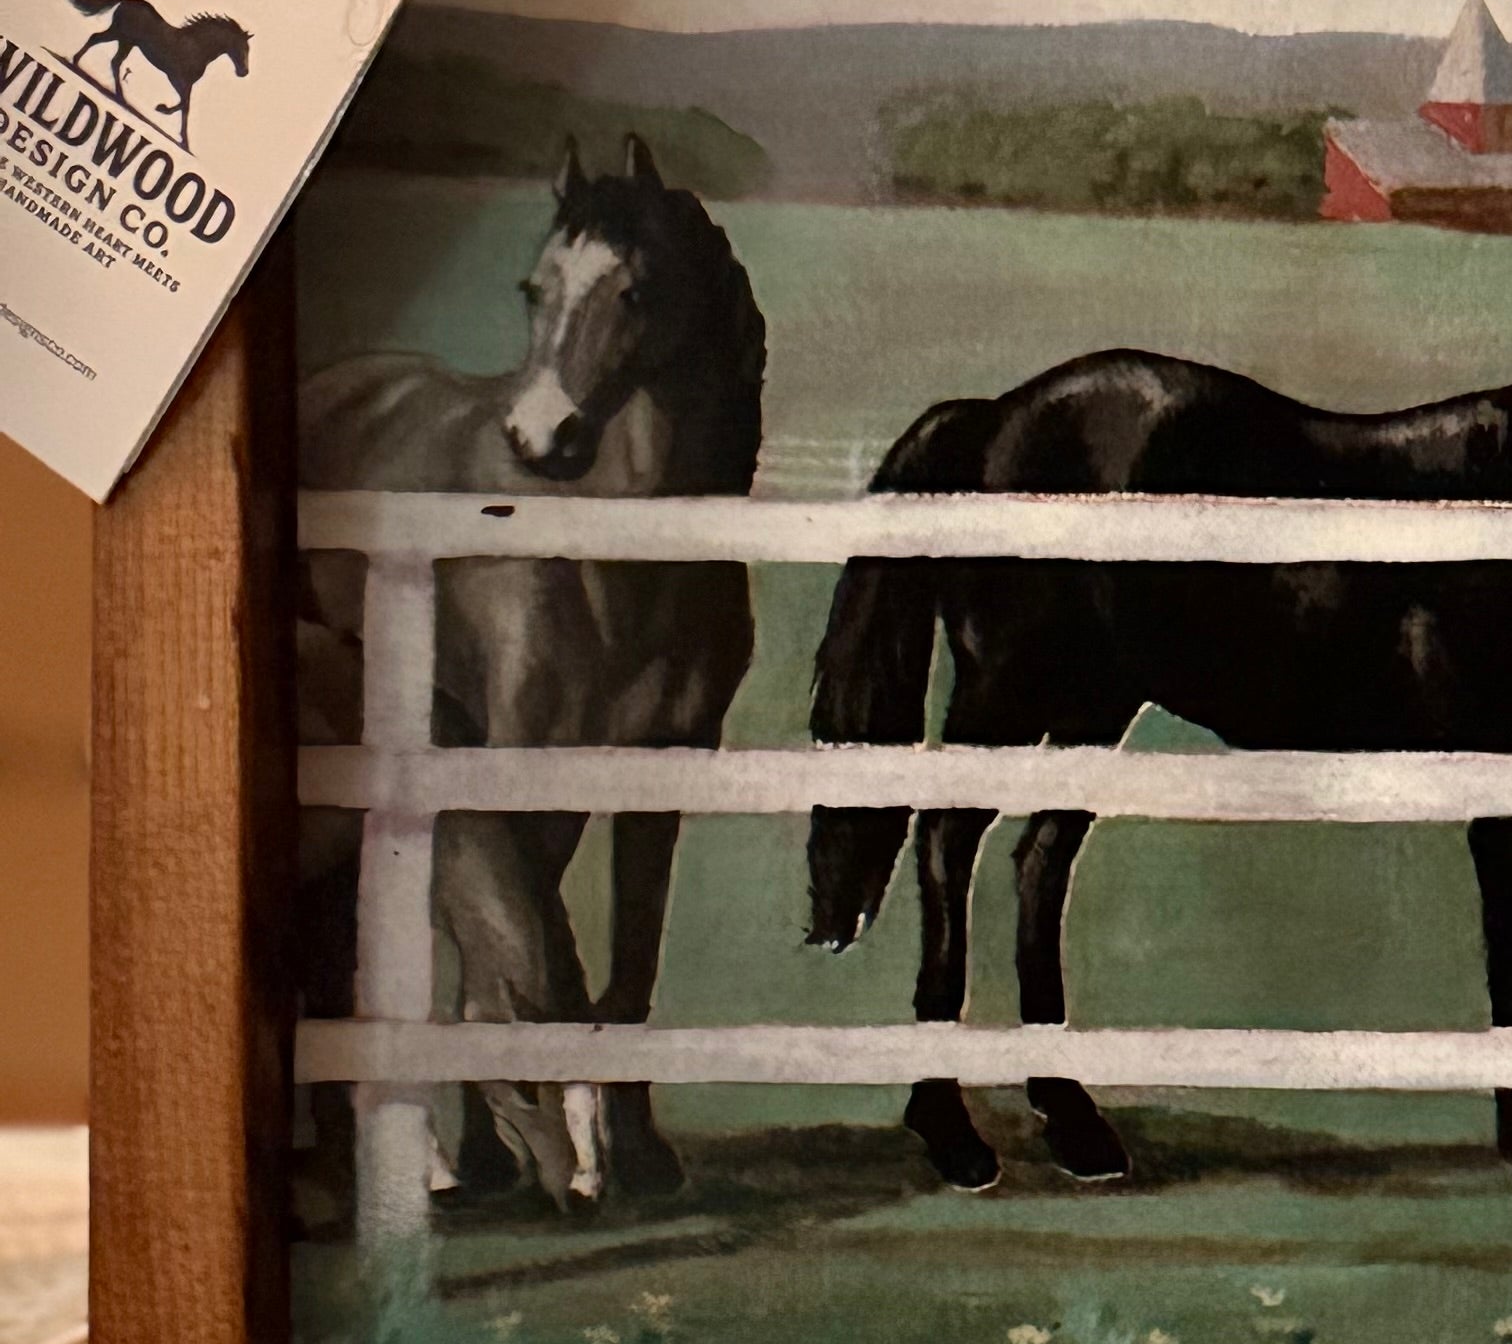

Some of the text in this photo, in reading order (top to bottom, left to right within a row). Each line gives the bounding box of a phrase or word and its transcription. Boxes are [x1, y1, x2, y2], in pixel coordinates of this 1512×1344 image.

[12, 164, 181, 293] WESTERN HEART MEETS
[82, 241, 117, 268] ART
[119, 203, 169, 258] CO.
